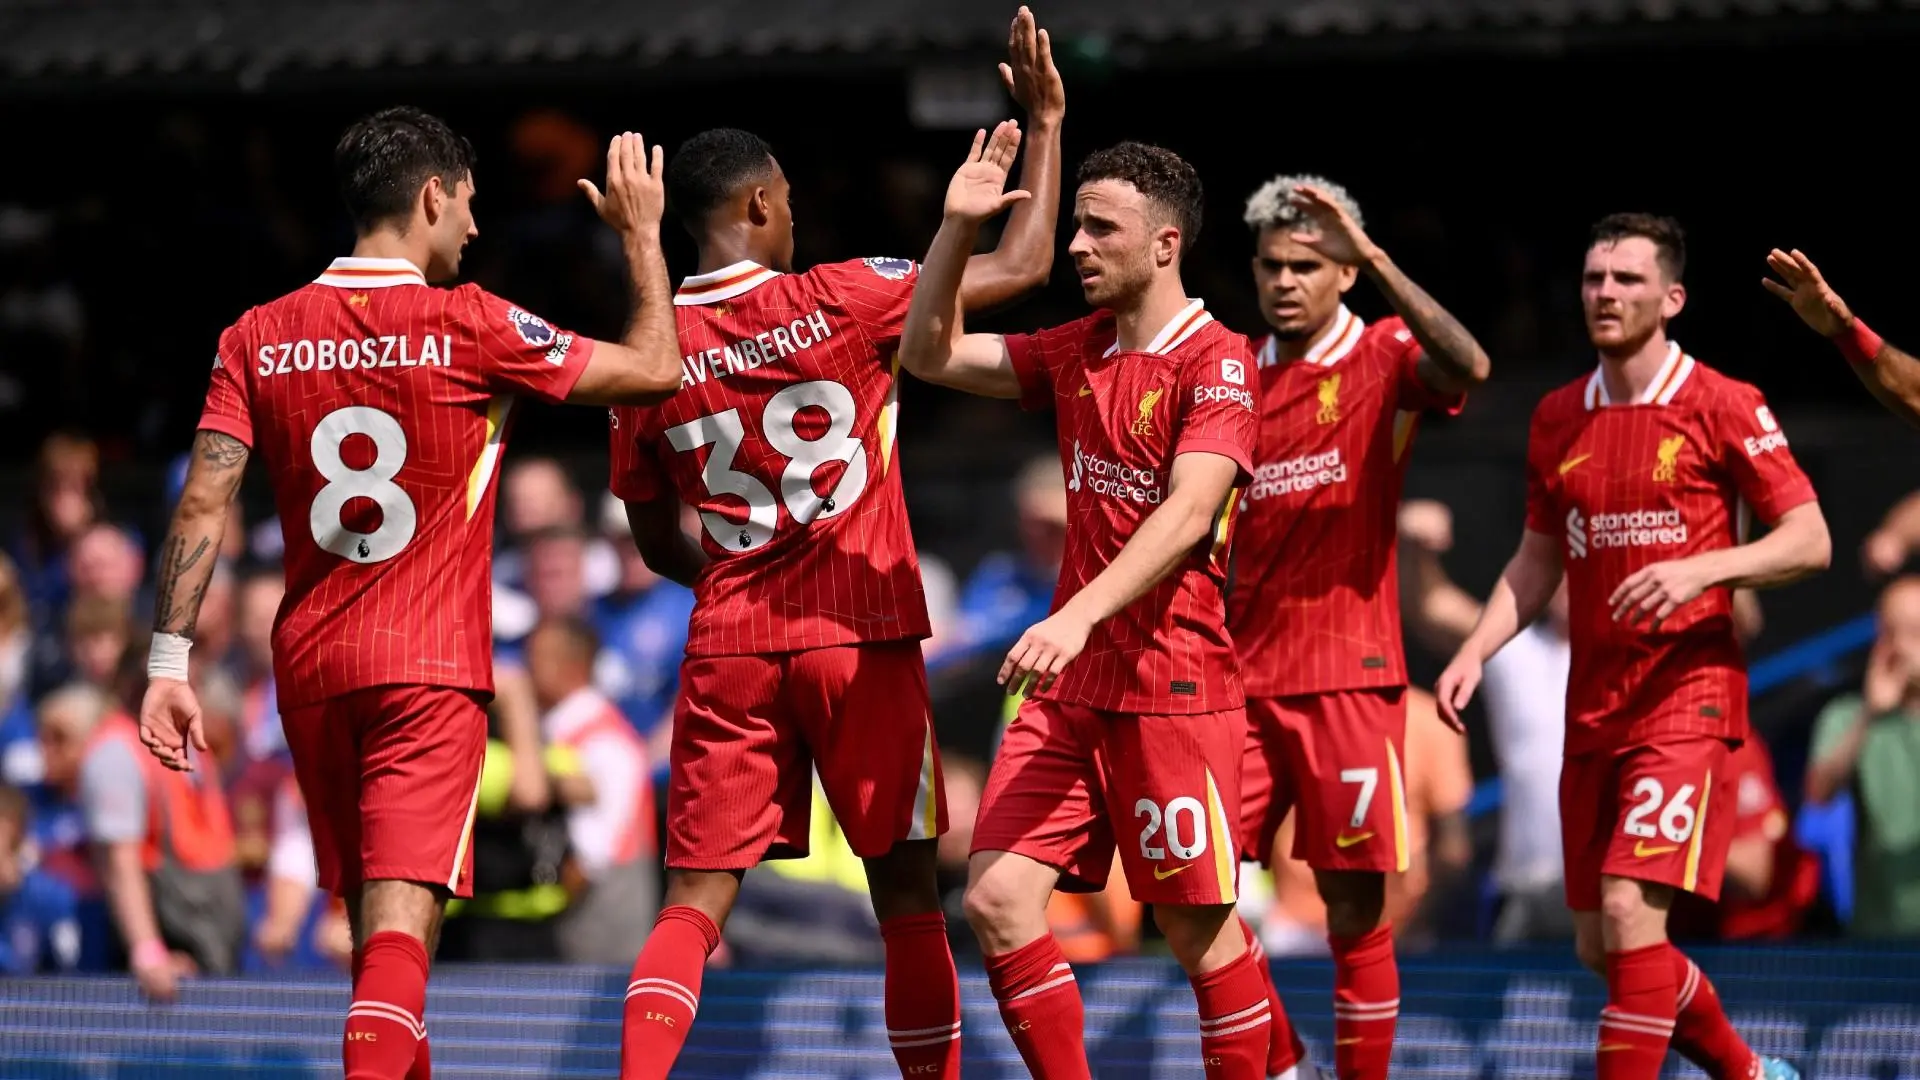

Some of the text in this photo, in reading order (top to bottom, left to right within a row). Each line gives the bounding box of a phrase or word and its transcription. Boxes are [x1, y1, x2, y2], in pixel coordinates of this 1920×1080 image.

[258, 335, 452, 377] SZOBOSZLAI
[680, 309, 833, 391] AVENBERCH
[310, 405, 417, 564] 8
[663, 379, 869, 552] 38
[1083, 453, 1155, 486] standard
[1251, 463, 1347, 500] chartered
[1590, 508, 1680, 532] standard
[1592, 524, 1688, 548] chartered
[1340, 767, 1378, 828] 7
[1623, 776, 1696, 844] 26
[1134, 796, 1208, 860] 20
[347, 1031, 377, 1042] LFC
[646, 1011, 676, 1028] LFC
[908, 1063, 938, 1074] LFC
